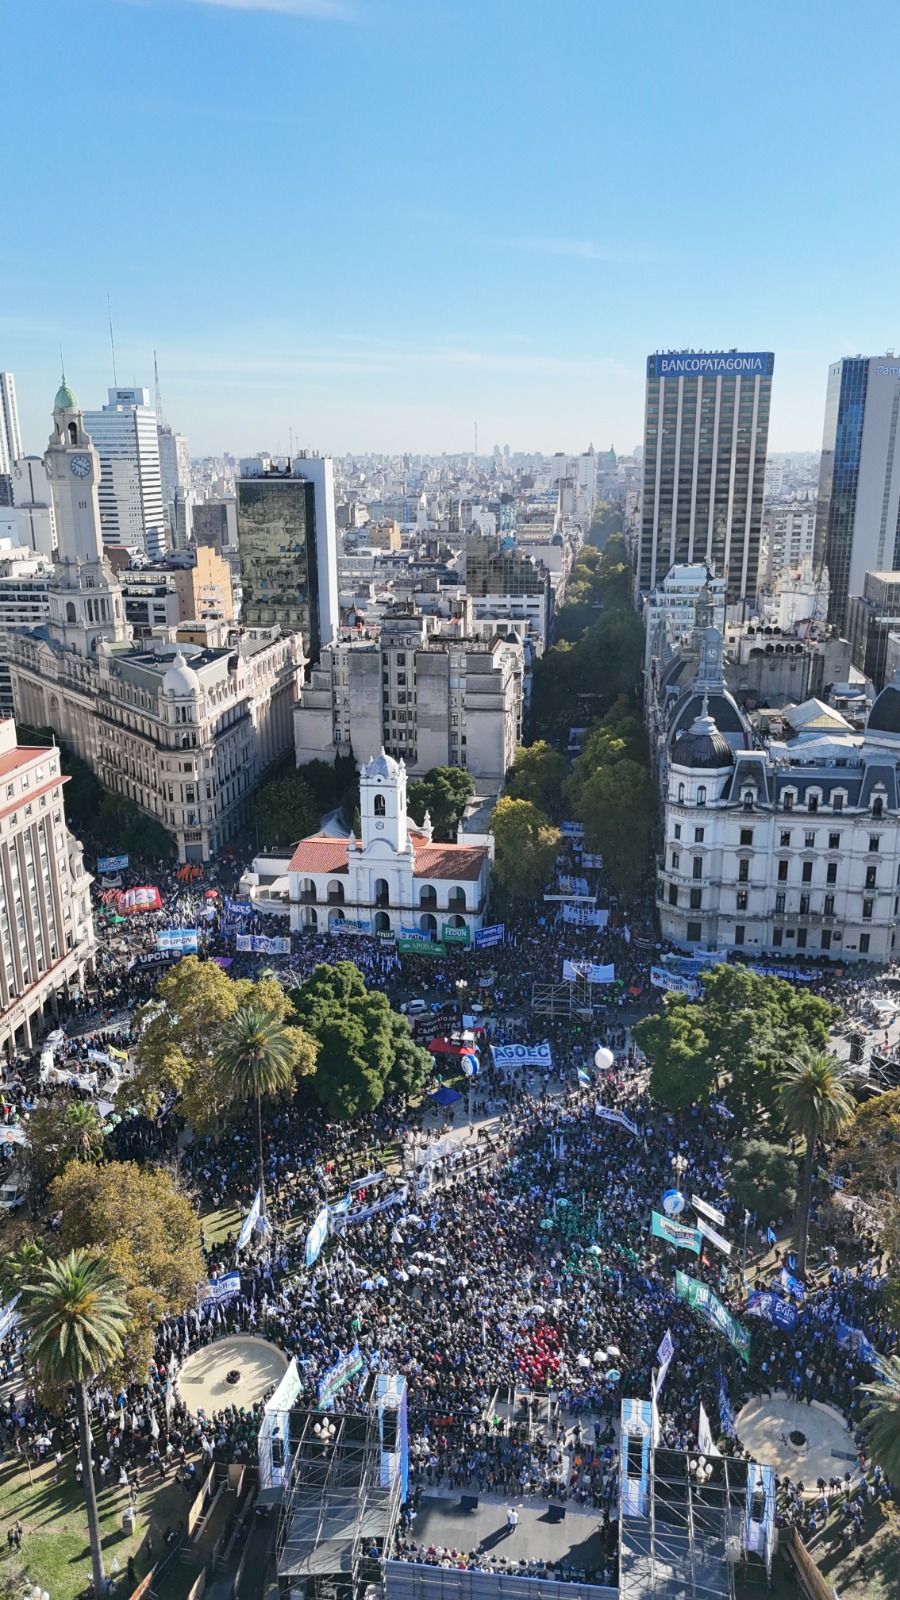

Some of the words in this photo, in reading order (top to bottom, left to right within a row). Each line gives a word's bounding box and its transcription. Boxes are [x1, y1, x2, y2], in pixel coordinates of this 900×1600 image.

[661, 358, 762, 371] BANCOPATAGONIA
[169, 937, 192, 945] UPCN
[411, 942, 434, 951] APUBA
[139, 950, 170, 963] UPCN
[494, 1045, 549, 1058] AGOEC
